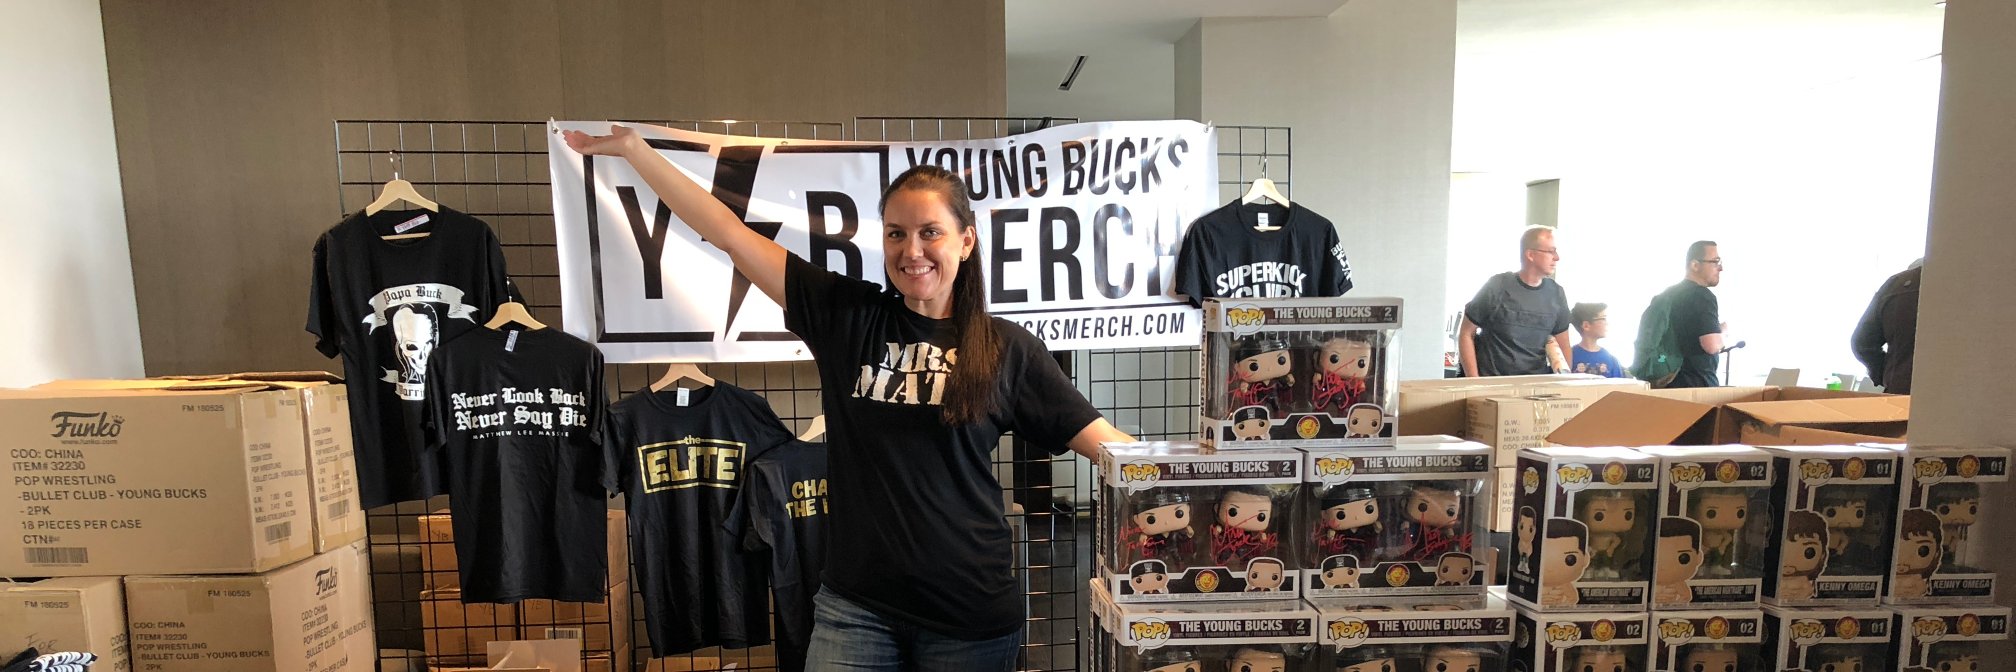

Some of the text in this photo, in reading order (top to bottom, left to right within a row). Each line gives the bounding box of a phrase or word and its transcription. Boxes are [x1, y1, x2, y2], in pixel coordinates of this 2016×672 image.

[616, 186, 863, 299] Y B
[971, 203, 1181, 304] ERCH
[383, 286, 442, 305] Papa Buck
[1228, 308, 1265, 326] POP!
[1273, 306, 1392, 319] THE YOUNG BUCKS 2
[451, 387, 586, 409] Never Look Back
[51, 411, 122, 438] Funko
[454, 406, 587, 430] Never Say Die
[473, 430, 512, 440] MATTHEW
[538, 430, 569, 438] MASSIE
[684, 434, 701, 444] the
[10, 448, 84, 458] COO: CHINA
[50, 461, 86, 470] 32230
[646, 446, 739, 485] ELITE
[1169, 461, 1291, 474] THE YOUNG BUCKS 2
[1316, 458, 1354, 476] POP!
[1362, 456, 1483, 468] THE YOUNG BUCKS 2
[1913, 460, 1948, 478] POP!
[1122, 464, 1160, 482] POP!
[1557, 466, 1650, 485] POP! 02
[1670, 466, 1764, 483] POP! 02
[1799, 462, 1889, 480] POP! 01
[15, 474, 116, 486] POP WRESTLING
[73, 490, 107, 500] CLUB
[116, 489, 162, 500] YOUNG
[164, 488, 207, 499] BUCKS
[27, 506, 51, 516] 2PK
[38, 520, 81, 530] PIECES
[84, 520, 108, 530] PER
[110, 520, 142, 529] CASE
[1820, 582, 1876, 592] KENNY OMEGA
[1934, 579, 1990, 590] KENNY OMEGA
[1132, 622, 1170, 640] POP!
[1179, 620, 1304, 632] THE YOUNG BUCKS 2
[1329, 620, 1368, 640] POP!
[1378, 618, 1504, 632] THE YOUNG BUCKS 2
[1545, 625, 1640, 642] POP! 02
[1658, 622, 1754, 639] POP! 02
[1789, 622, 1884, 640] POP! 01
[1912, 619, 1948, 637] POP!
[156, 642, 208, 650] WRESTLING
[176, 652, 200, 660] CLUB
[240, 650, 270, 658] BUCKS
